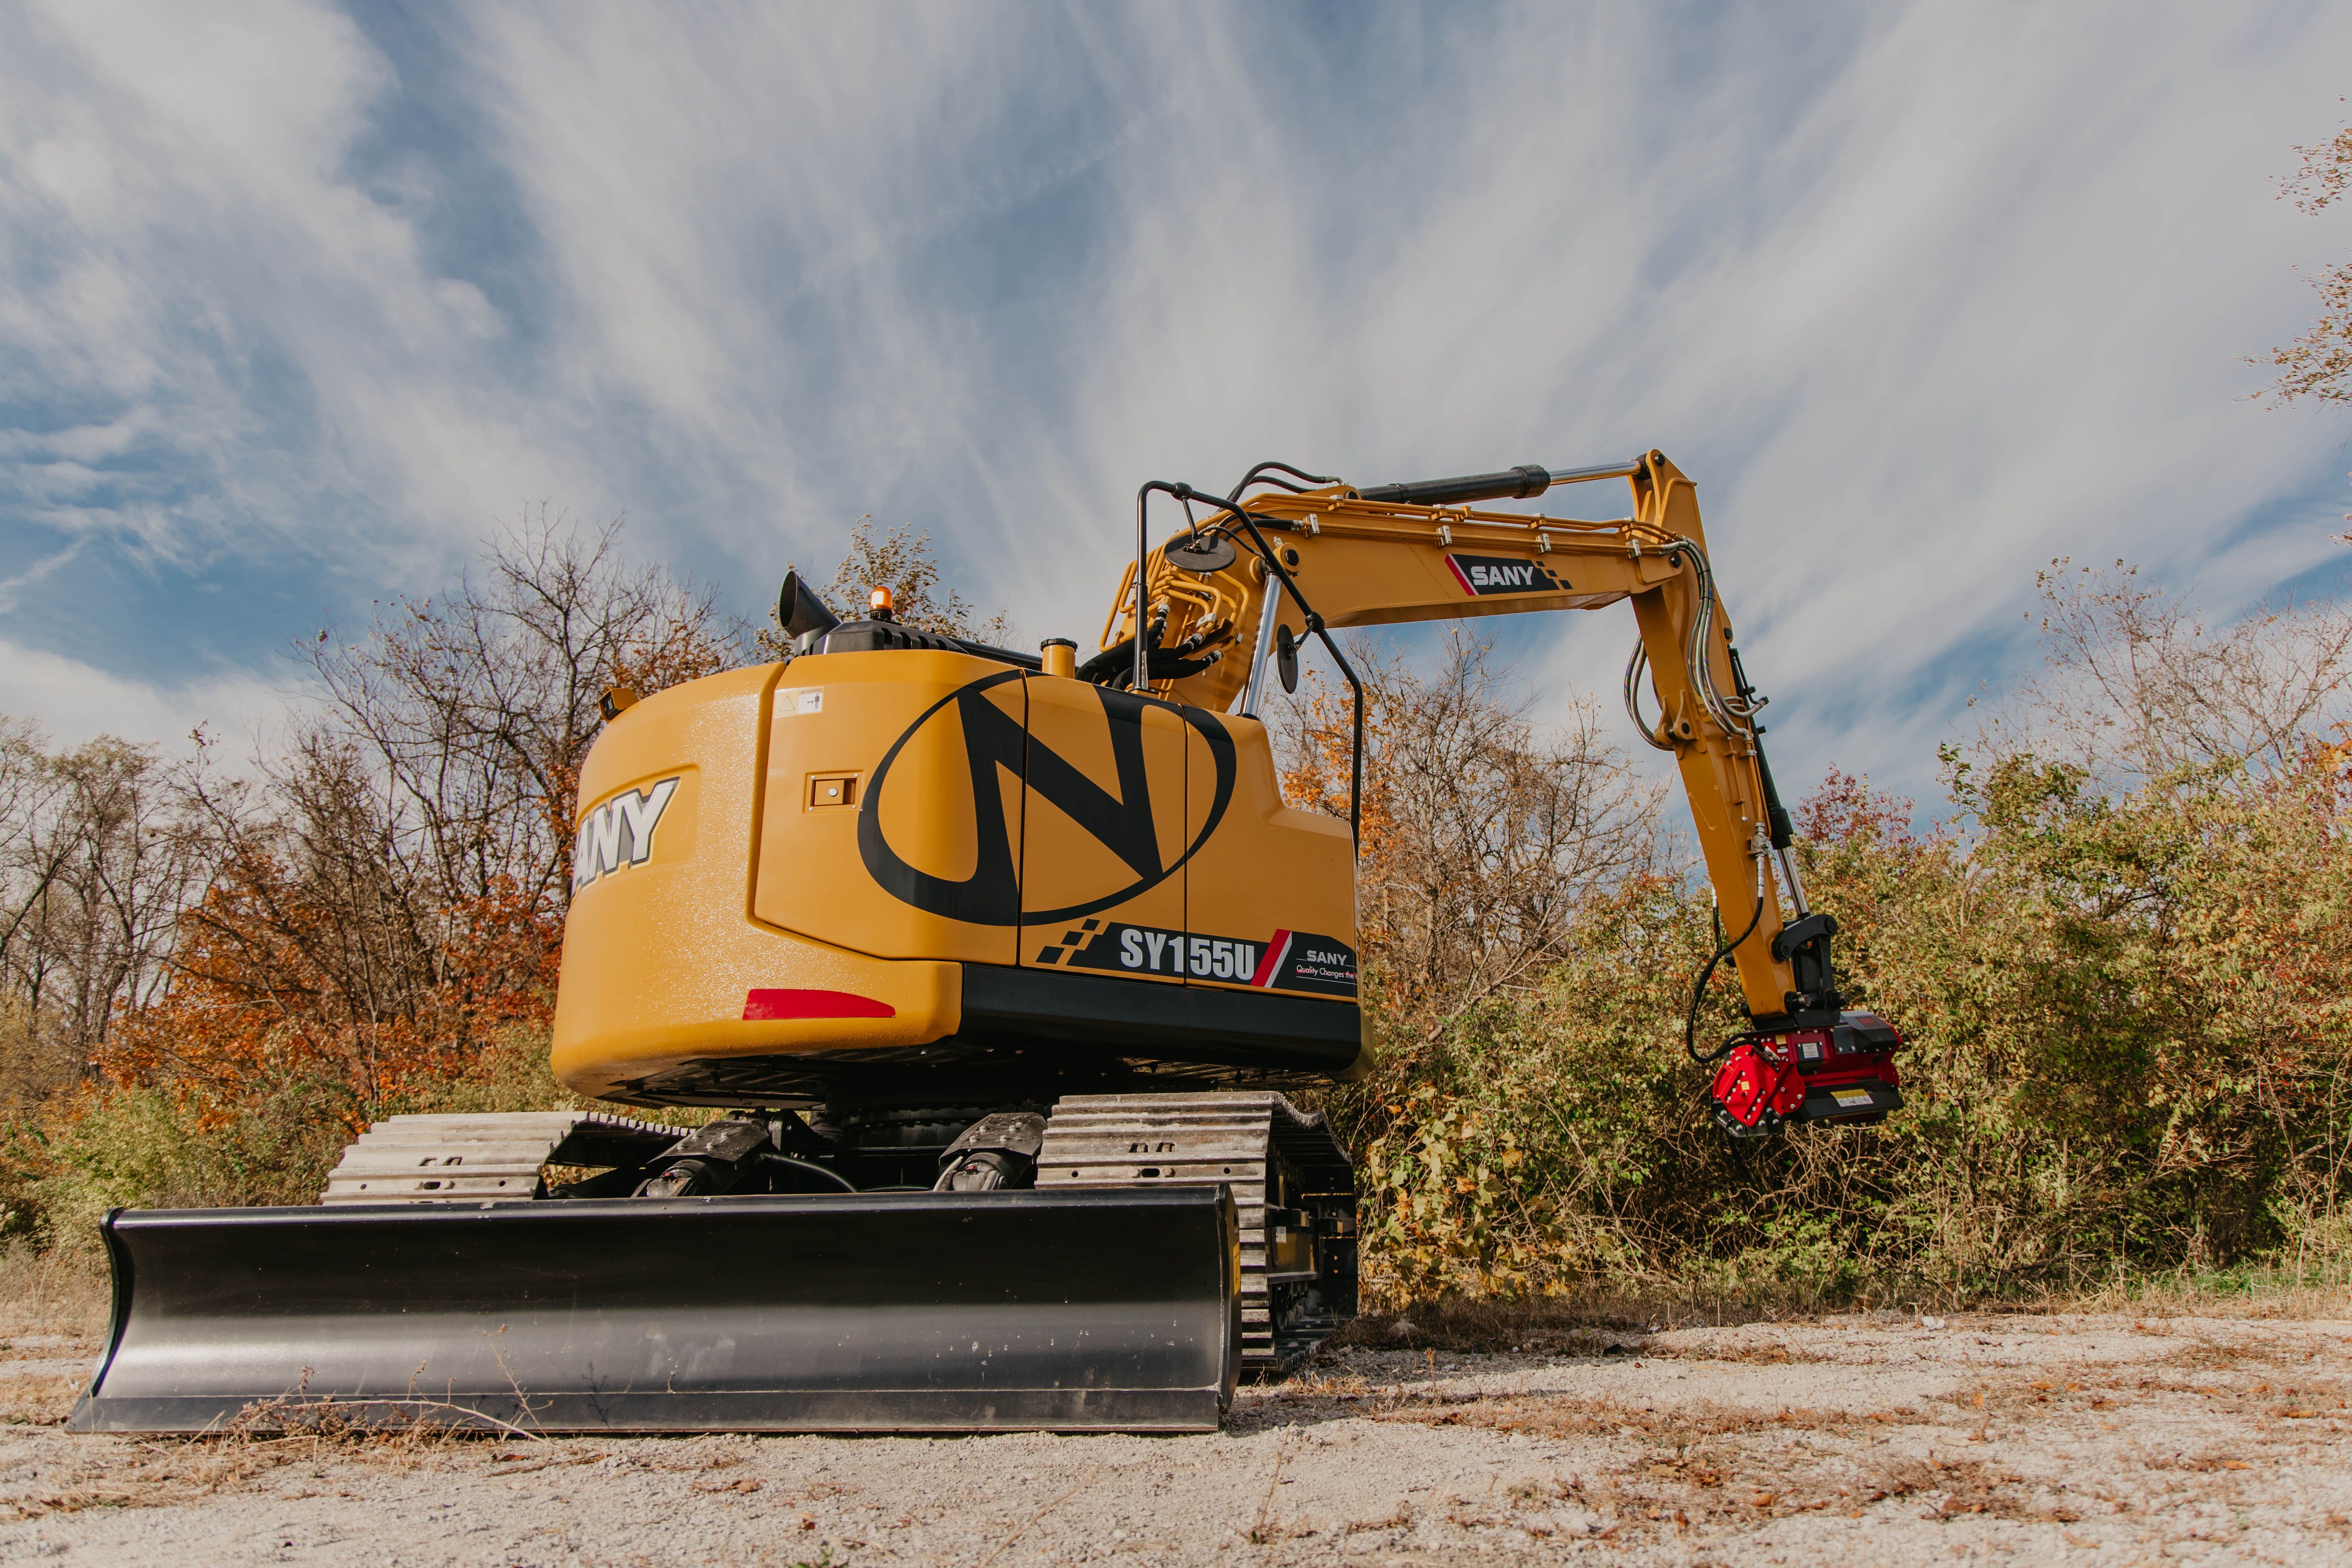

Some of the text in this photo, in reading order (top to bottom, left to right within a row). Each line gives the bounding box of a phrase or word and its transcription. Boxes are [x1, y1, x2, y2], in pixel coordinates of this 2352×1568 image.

[1471, 566, 1533, 586] SANY
[1121, 929, 1254, 980] SY155U
[1307, 950, 1347, 966] SANY
[1296, 965, 1318, 976] Quality
[1319, 967, 1344, 979] Changes
[1345, 971, 1353, 979] the
